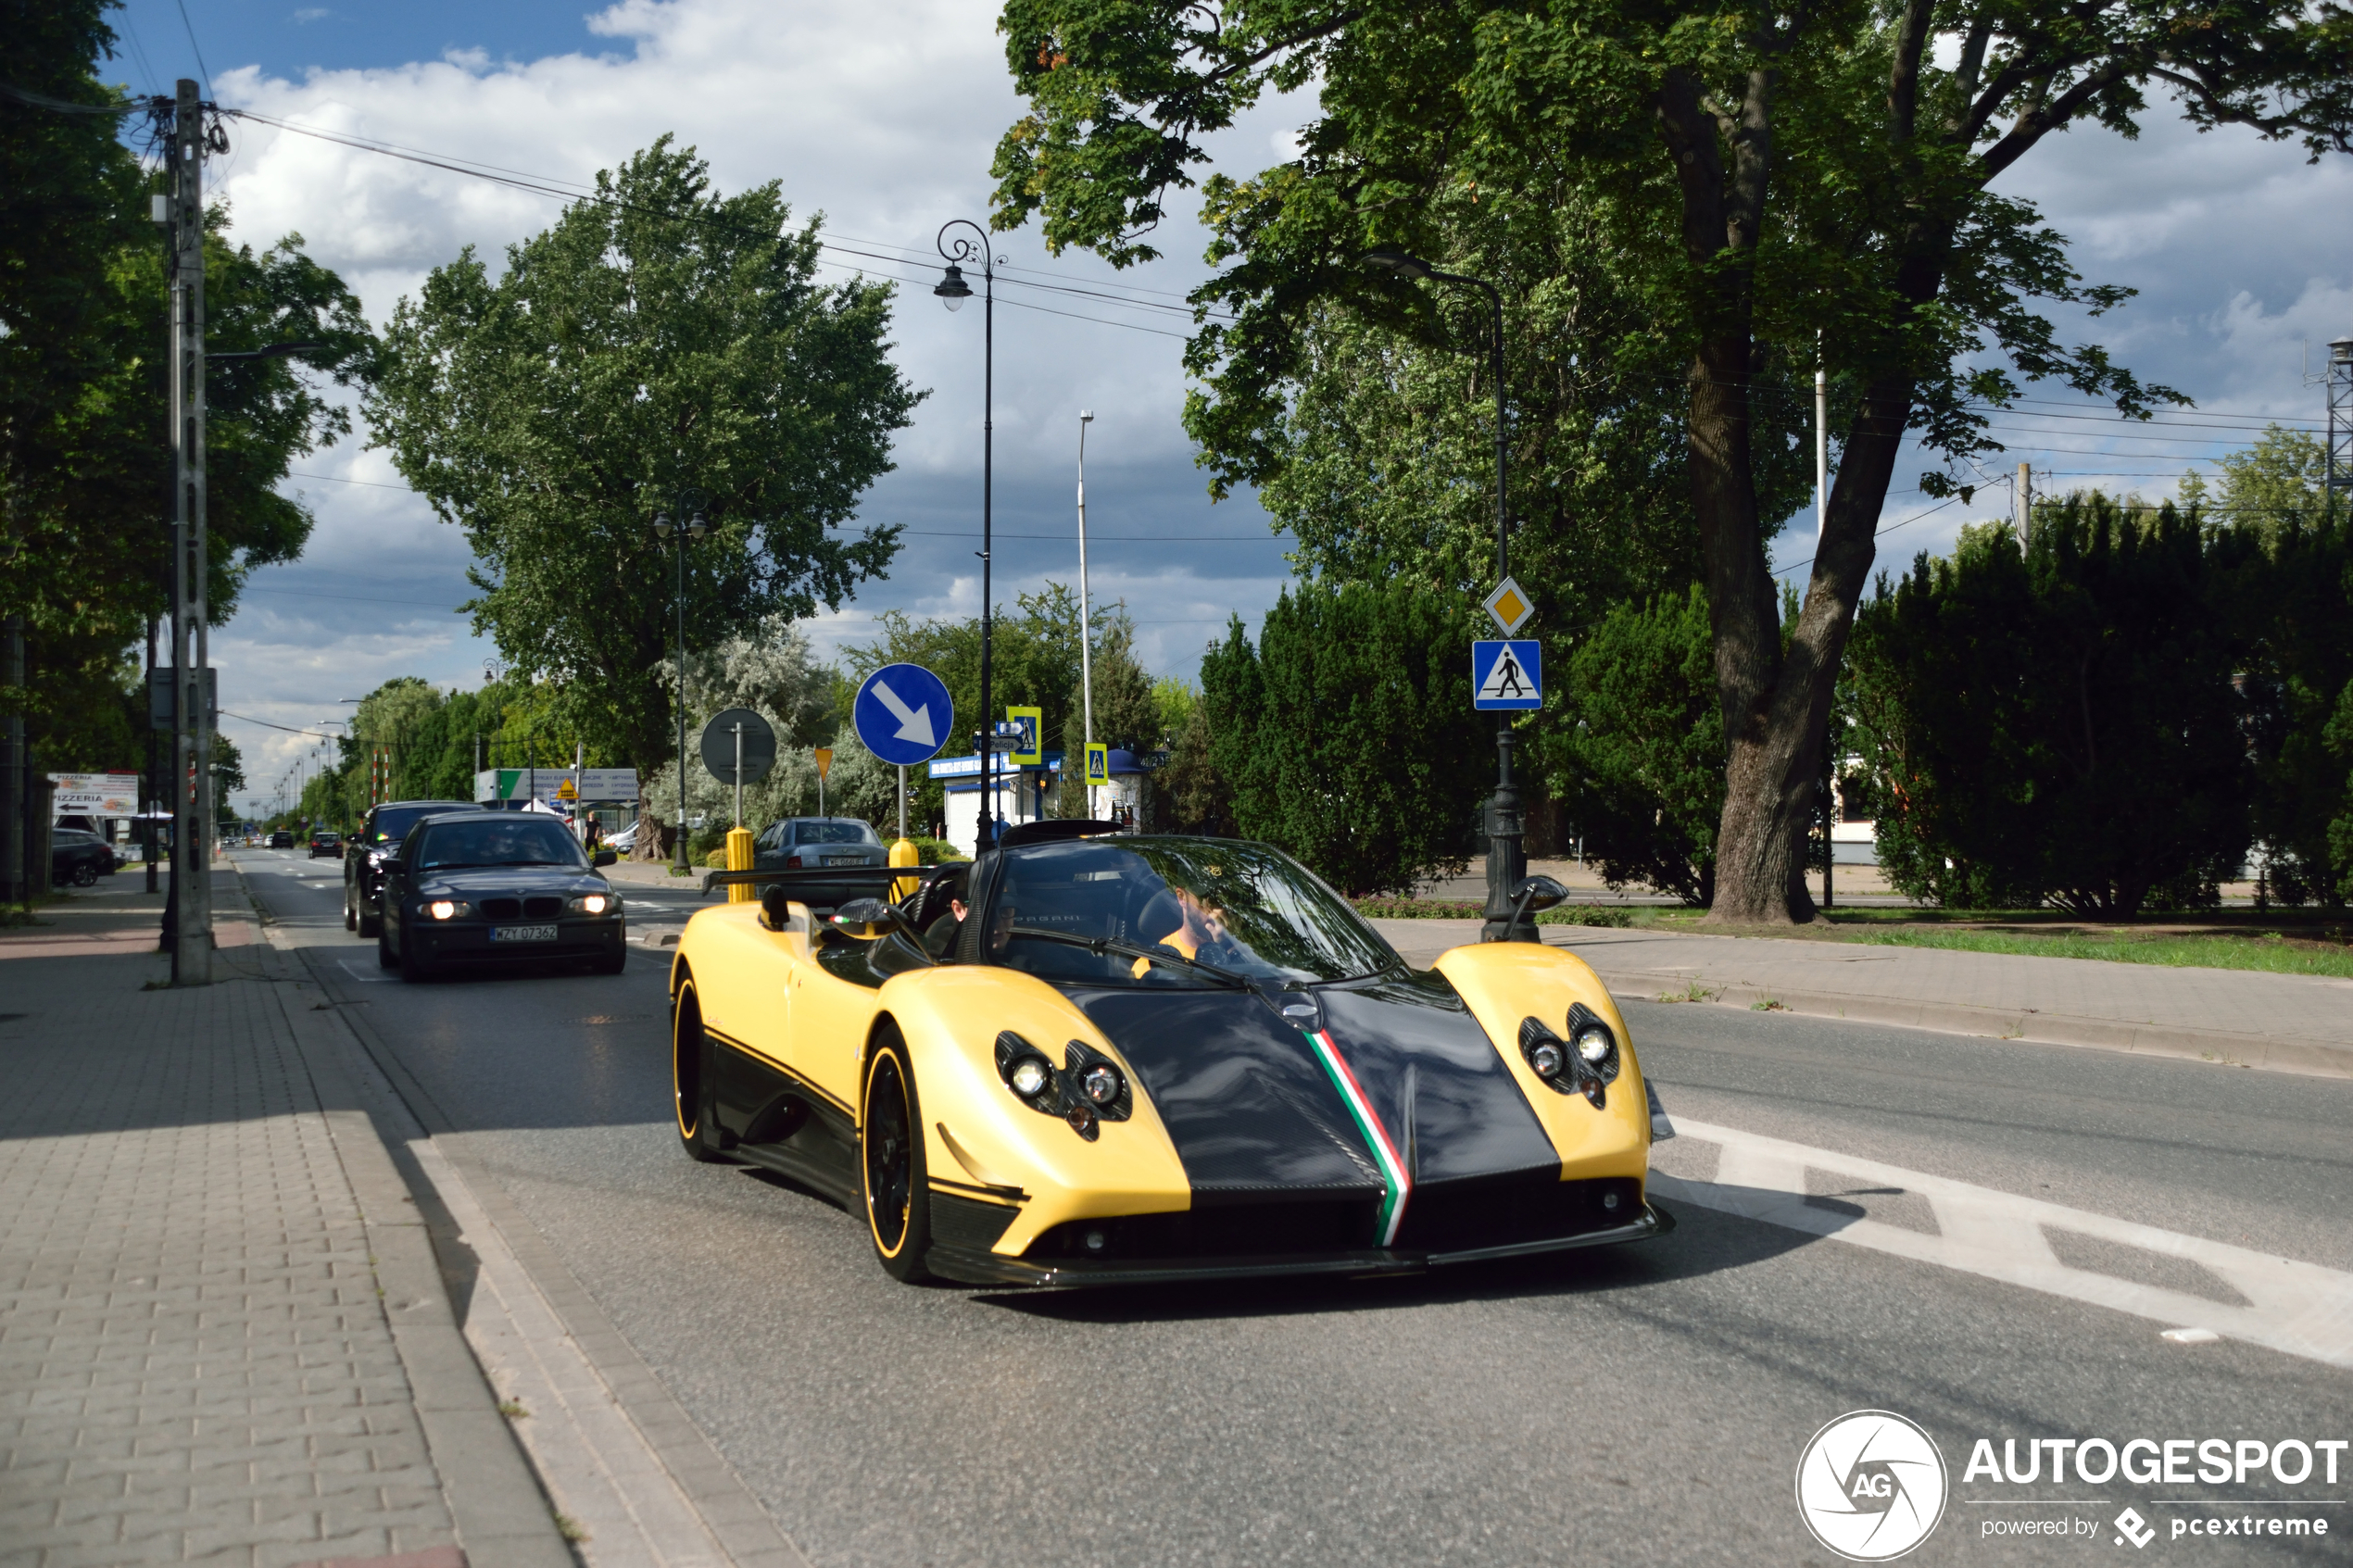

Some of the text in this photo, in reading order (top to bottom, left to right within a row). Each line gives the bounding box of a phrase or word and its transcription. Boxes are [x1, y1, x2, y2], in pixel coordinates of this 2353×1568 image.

[989, 740, 1014, 750] Policja
[496, 927, 556, 940] WZY 07362
